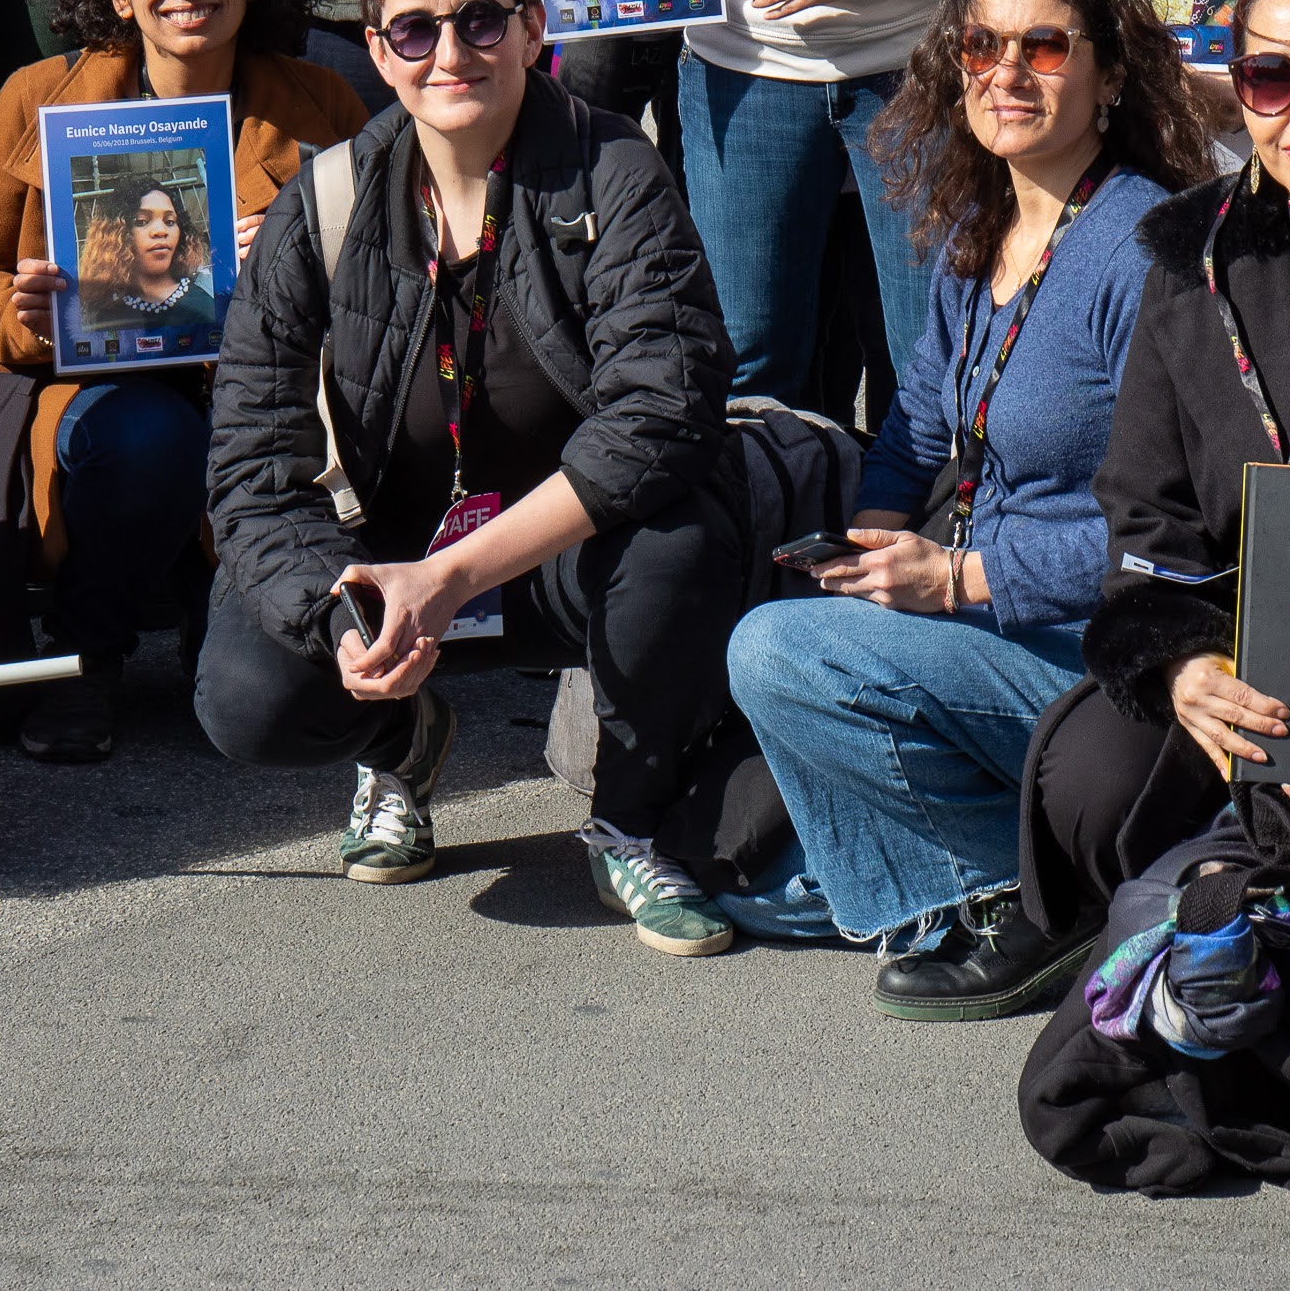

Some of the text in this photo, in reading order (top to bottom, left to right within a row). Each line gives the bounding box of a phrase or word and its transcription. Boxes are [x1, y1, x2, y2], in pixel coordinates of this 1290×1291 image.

[66, 117, 208, 138] Eunice Nancy Osayande
[92, 139, 129, 148] 05/06/2018
[158, 135, 183, 144] Belgium
